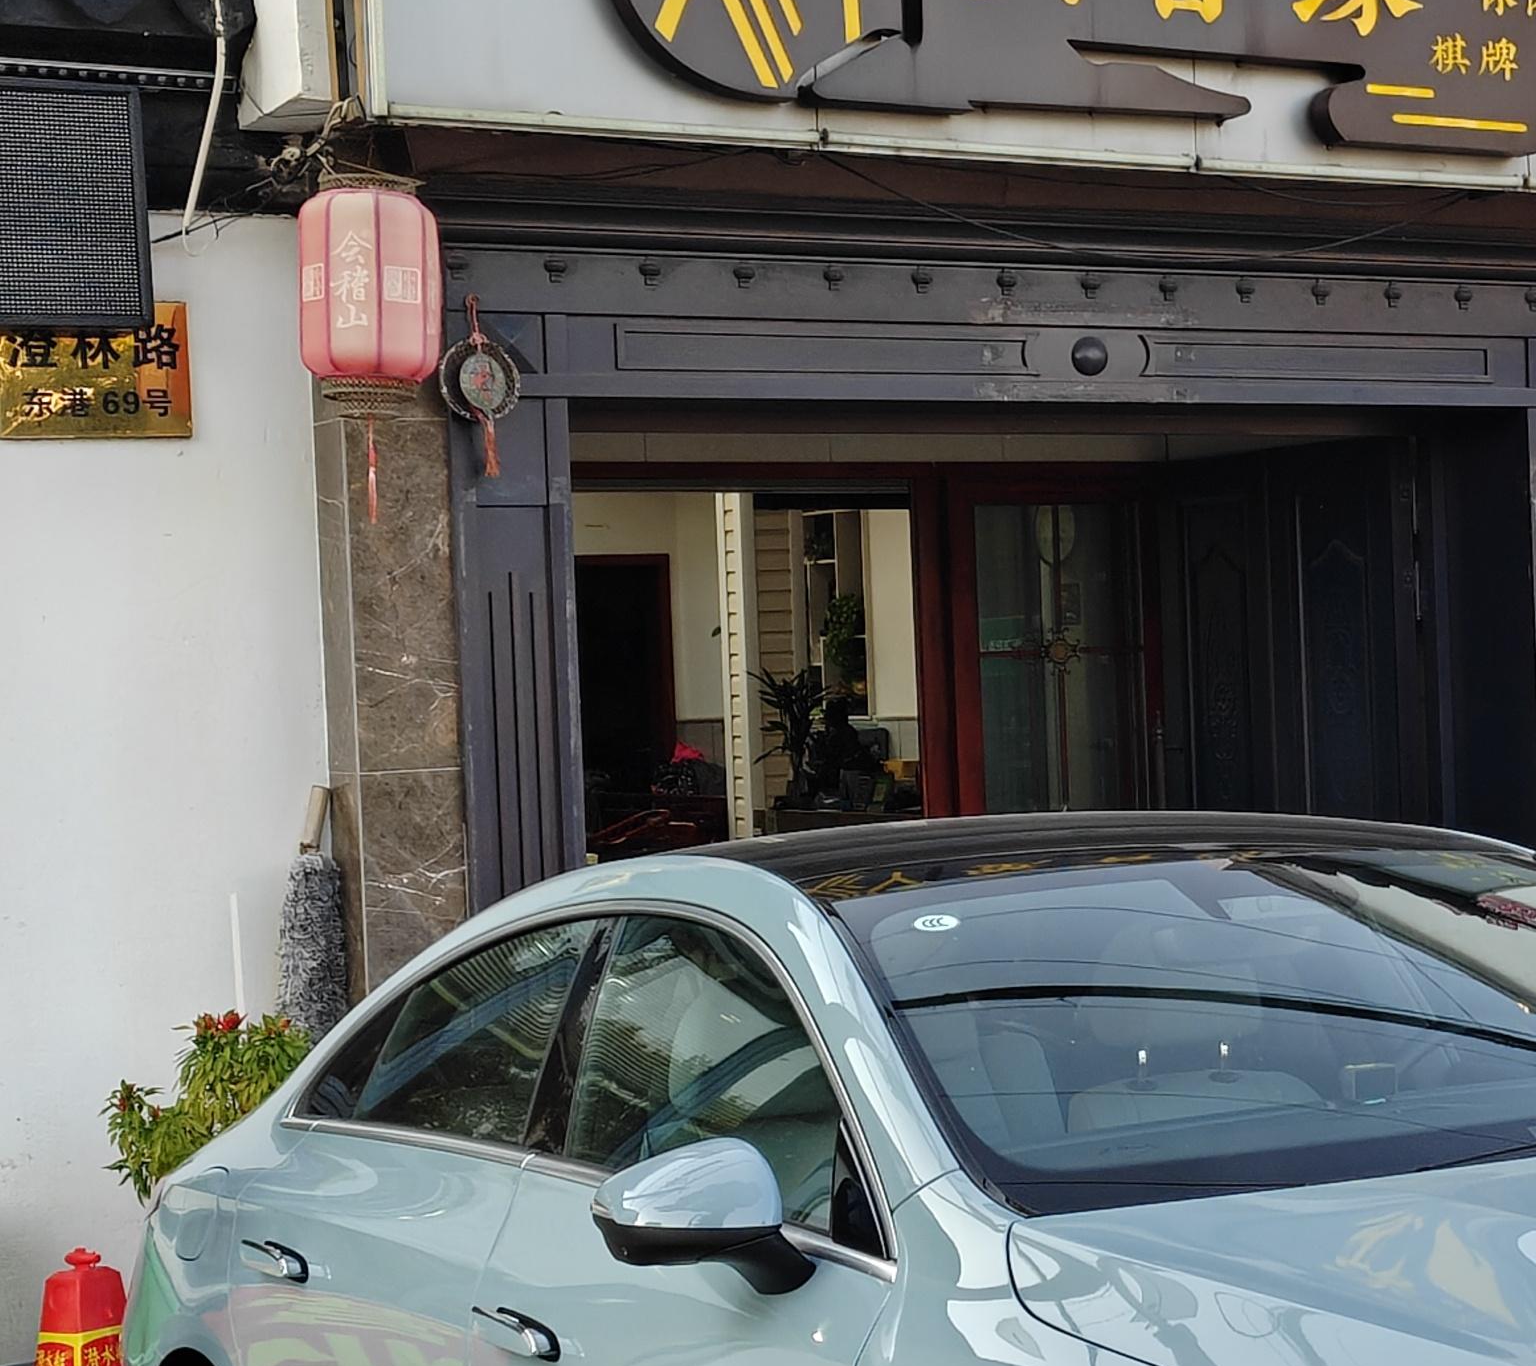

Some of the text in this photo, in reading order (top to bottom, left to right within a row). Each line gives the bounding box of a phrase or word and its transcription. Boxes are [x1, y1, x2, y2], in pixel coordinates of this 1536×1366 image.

[1429, 32, 1520, 82] 棋牌
[330, 230, 373, 329] 会稽山
